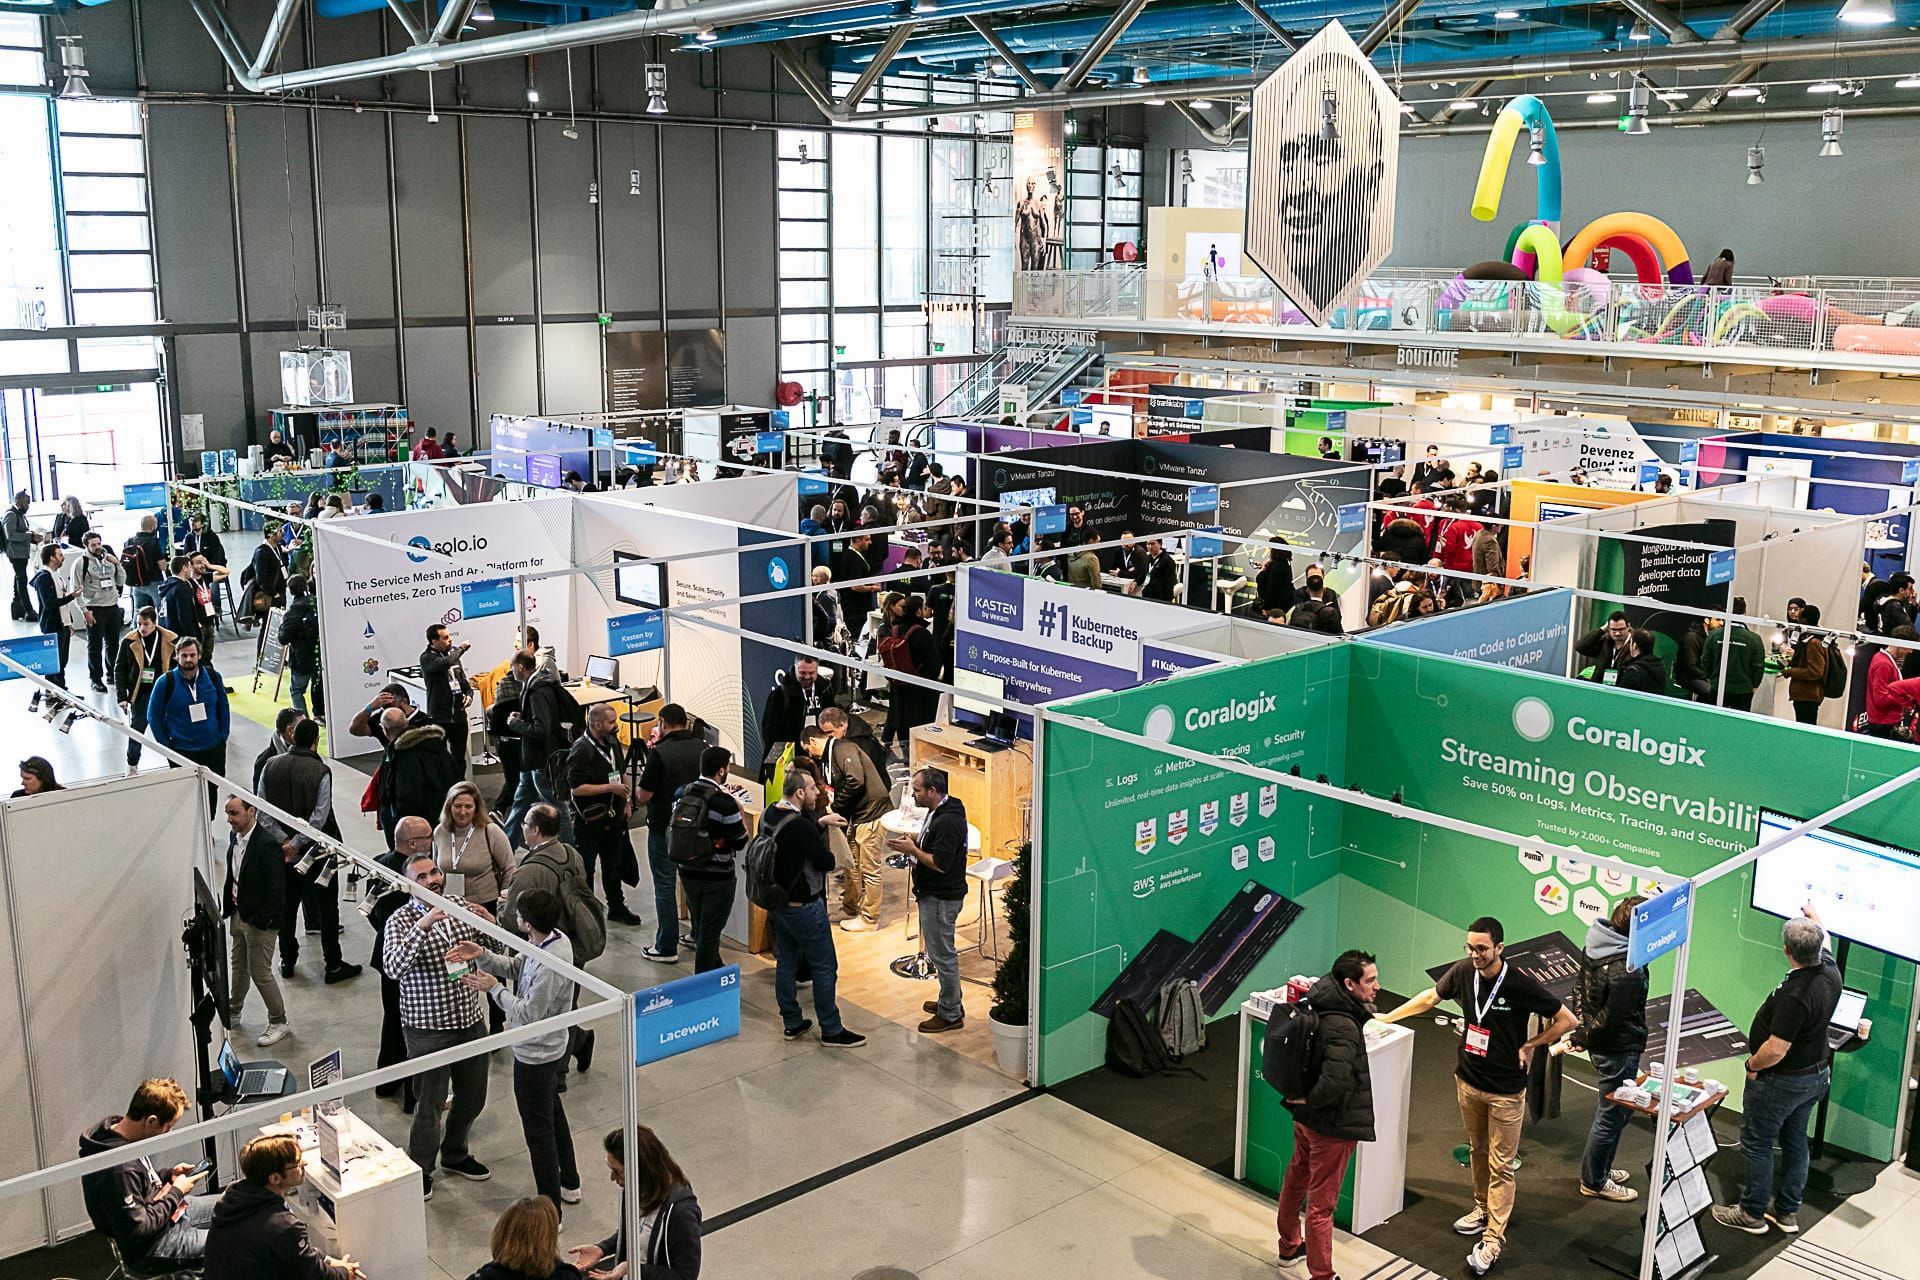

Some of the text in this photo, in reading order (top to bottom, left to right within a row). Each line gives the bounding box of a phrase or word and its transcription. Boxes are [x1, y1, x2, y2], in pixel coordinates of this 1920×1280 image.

[1060, 332, 1096, 346] ENFANTS
[1396, 348, 1459, 368] BOUTIQUE
[1580, 444, 1635, 460] Devenez
[1010, 470, 1056, 481] VMware Tanzu
[1159, 463, 1207, 476] VMware Tanzu
[1062, 495, 1073, 503] The
[1075, 492, 1097, 501] smarter
[1141, 488, 1160, 498] Multi
[1161, 490, 1183, 502] Cloud
[1141, 500, 1172, 512] At Scale
[1104, 514, 1127, 524] demand
[1140, 513, 1156, 522] Your
[1157, 515, 1179, 526] golden
[1180, 520, 1196, 529] path
[434, 534, 488, 555] solo.io
[1640, 553, 1705, 568] The multi-cloud
[346, 580, 367, 592] The
[370, 575, 411, 588] Service
[413, 571, 442, 584] Mesh
[444, 567, 464, 580] and
[530, 557, 544, 568] for
[1638, 569, 1676, 583] developer
[1677, 567, 1701, 577] data
[343, 584, 461, 607] Kubernetes, Zero Trus
[1636, 583, 1670, 596] platform.
[975, 597, 1017, 616] KASTEN
[982, 611, 1010, 623] by Veeam
[1038, 601, 1138, 641] #1 Kubernetes
[621, 631, 654, 643] Kasten by
[1072, 631, 1113, 654] Backup
[1479, 642, 1504, 656] Code
[1506, 638, 1516, 649] to
[1518, 627, 1545, 646] Cloud
[1546, 623, 1567, 638] with
[626, 641, 649, 650] Veeam
[982, 650, 1083, 683] Purpose-Built for Kubernetes
[1506, 649, 1543, 668] CNAPP
[1010, 676, 1052, 695] Everywhere
[1185, 691, 1278, 732] Coralogix
[1274, 729, 1305, 745] Security
[1567, 716, 1706, 767] Coralogix
[1222, 743, 1250, 759] Tracing
[1165, 757, 1196, 774] Metrics
[1441, 737, 1575, 796] Streaming
[1117, 772, 1138, 787] Logs
[1104, 794, 1136, 809] Unlimited,
[1137, 786, 1164, 801] real-time
[1165, 782, 1179, 794] data
[1179, 775, 1202, 791] insights
[1203, 772, 1211, 783] at
[1462, 776, 1488, 791] Save
[1491, 783, 1517, 798] 50%
[1519, 791, 1533, 802] on
[1536, 793, 1567, 811] Logs,
[1570, 801, 1616, 823] Metrics,
[1619, 812, 1667, 836] Tracing,
[1670, 827, 1694, 841] and
[1537, 819, 1567, 835] Trusted
[1568, 827, 1579, 838] by
[1612, 839, 1661, 858] Companies
[1160, 868, 1183, 881] Available
[1133, 876, 1155, 892] aws
[1160, 881, 1172, 890] AWS
[1640, 911, 1648, 923] C5
[1647, 929, 1678, 953] Coralogix
[720, 973, 736, 987] B3
[660, 1016, 720, 1044] Lacework
